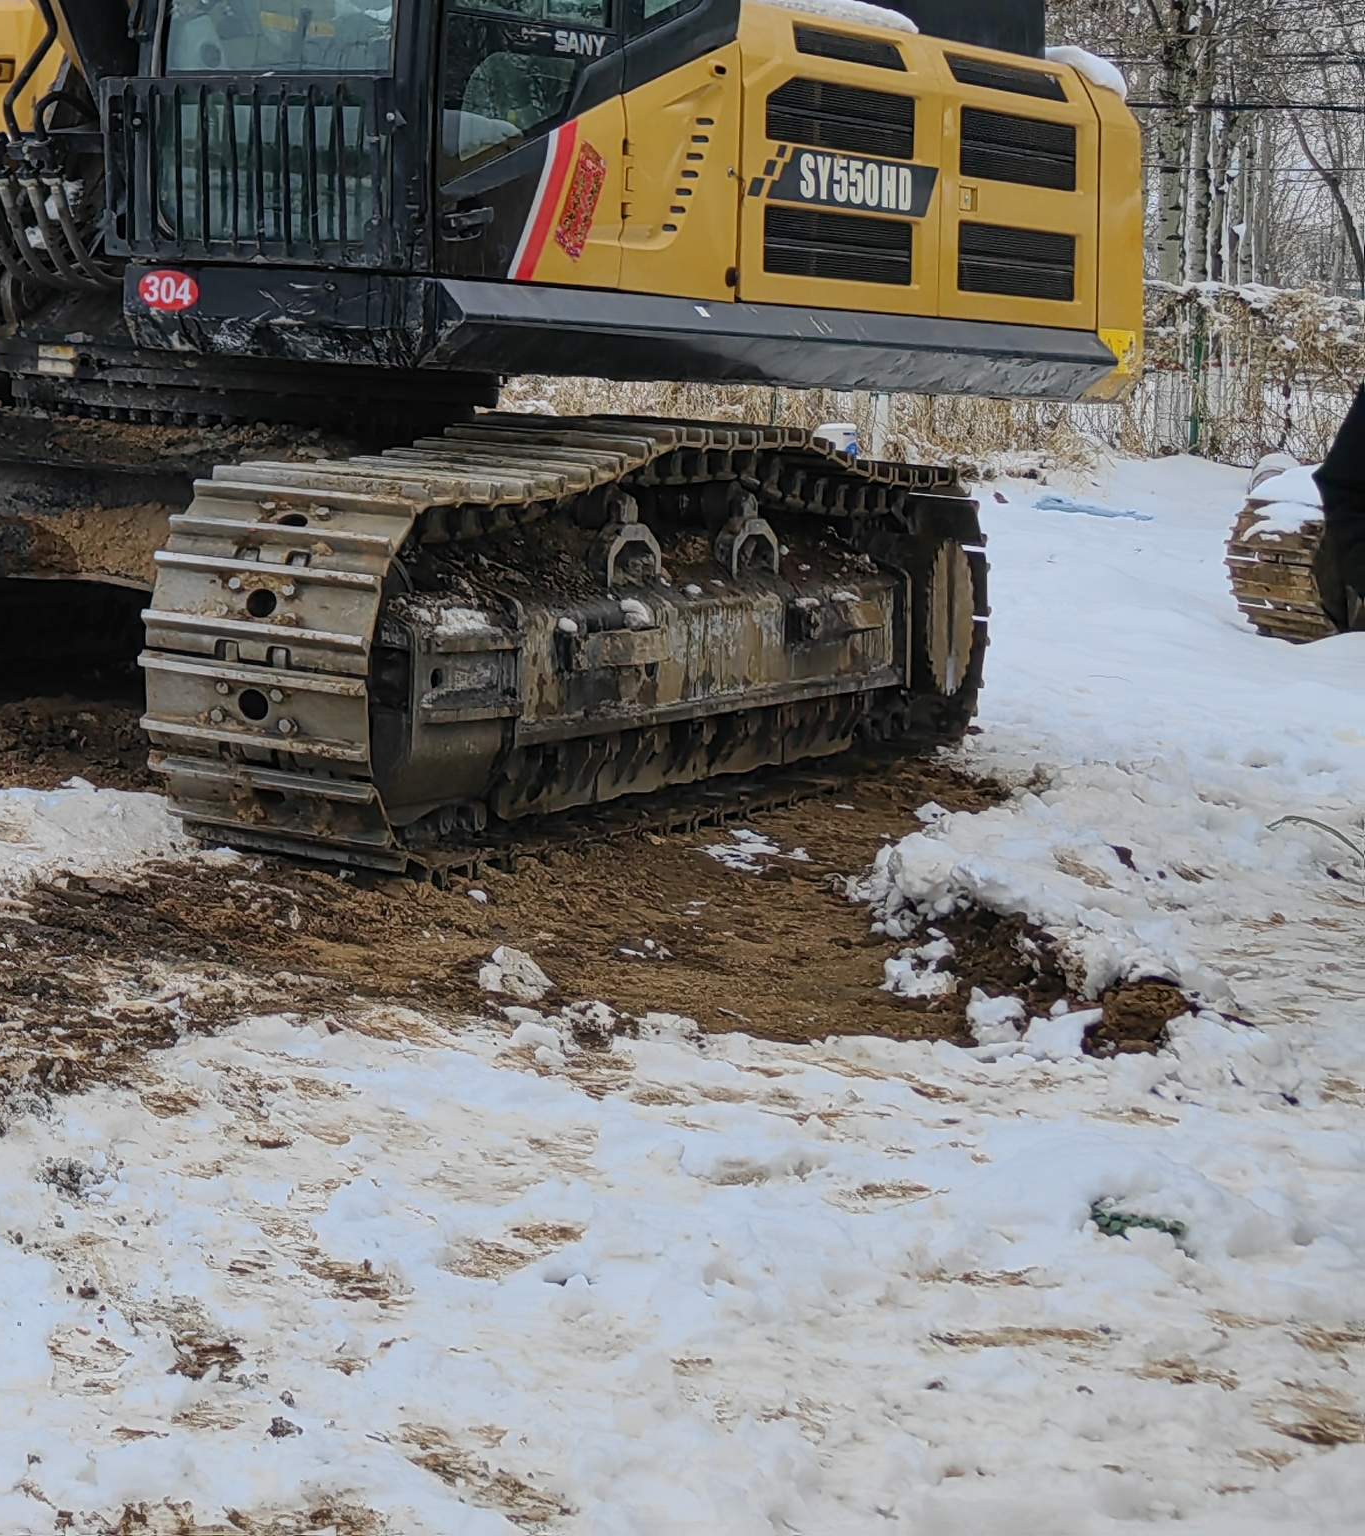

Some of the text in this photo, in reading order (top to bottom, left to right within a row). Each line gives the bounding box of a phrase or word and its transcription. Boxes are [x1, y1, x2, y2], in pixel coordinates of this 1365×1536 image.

[553, 29, 607, 57] SANY
[799, 152, 913, 212] SY550HD
[143, 274, 192, 307] 304
